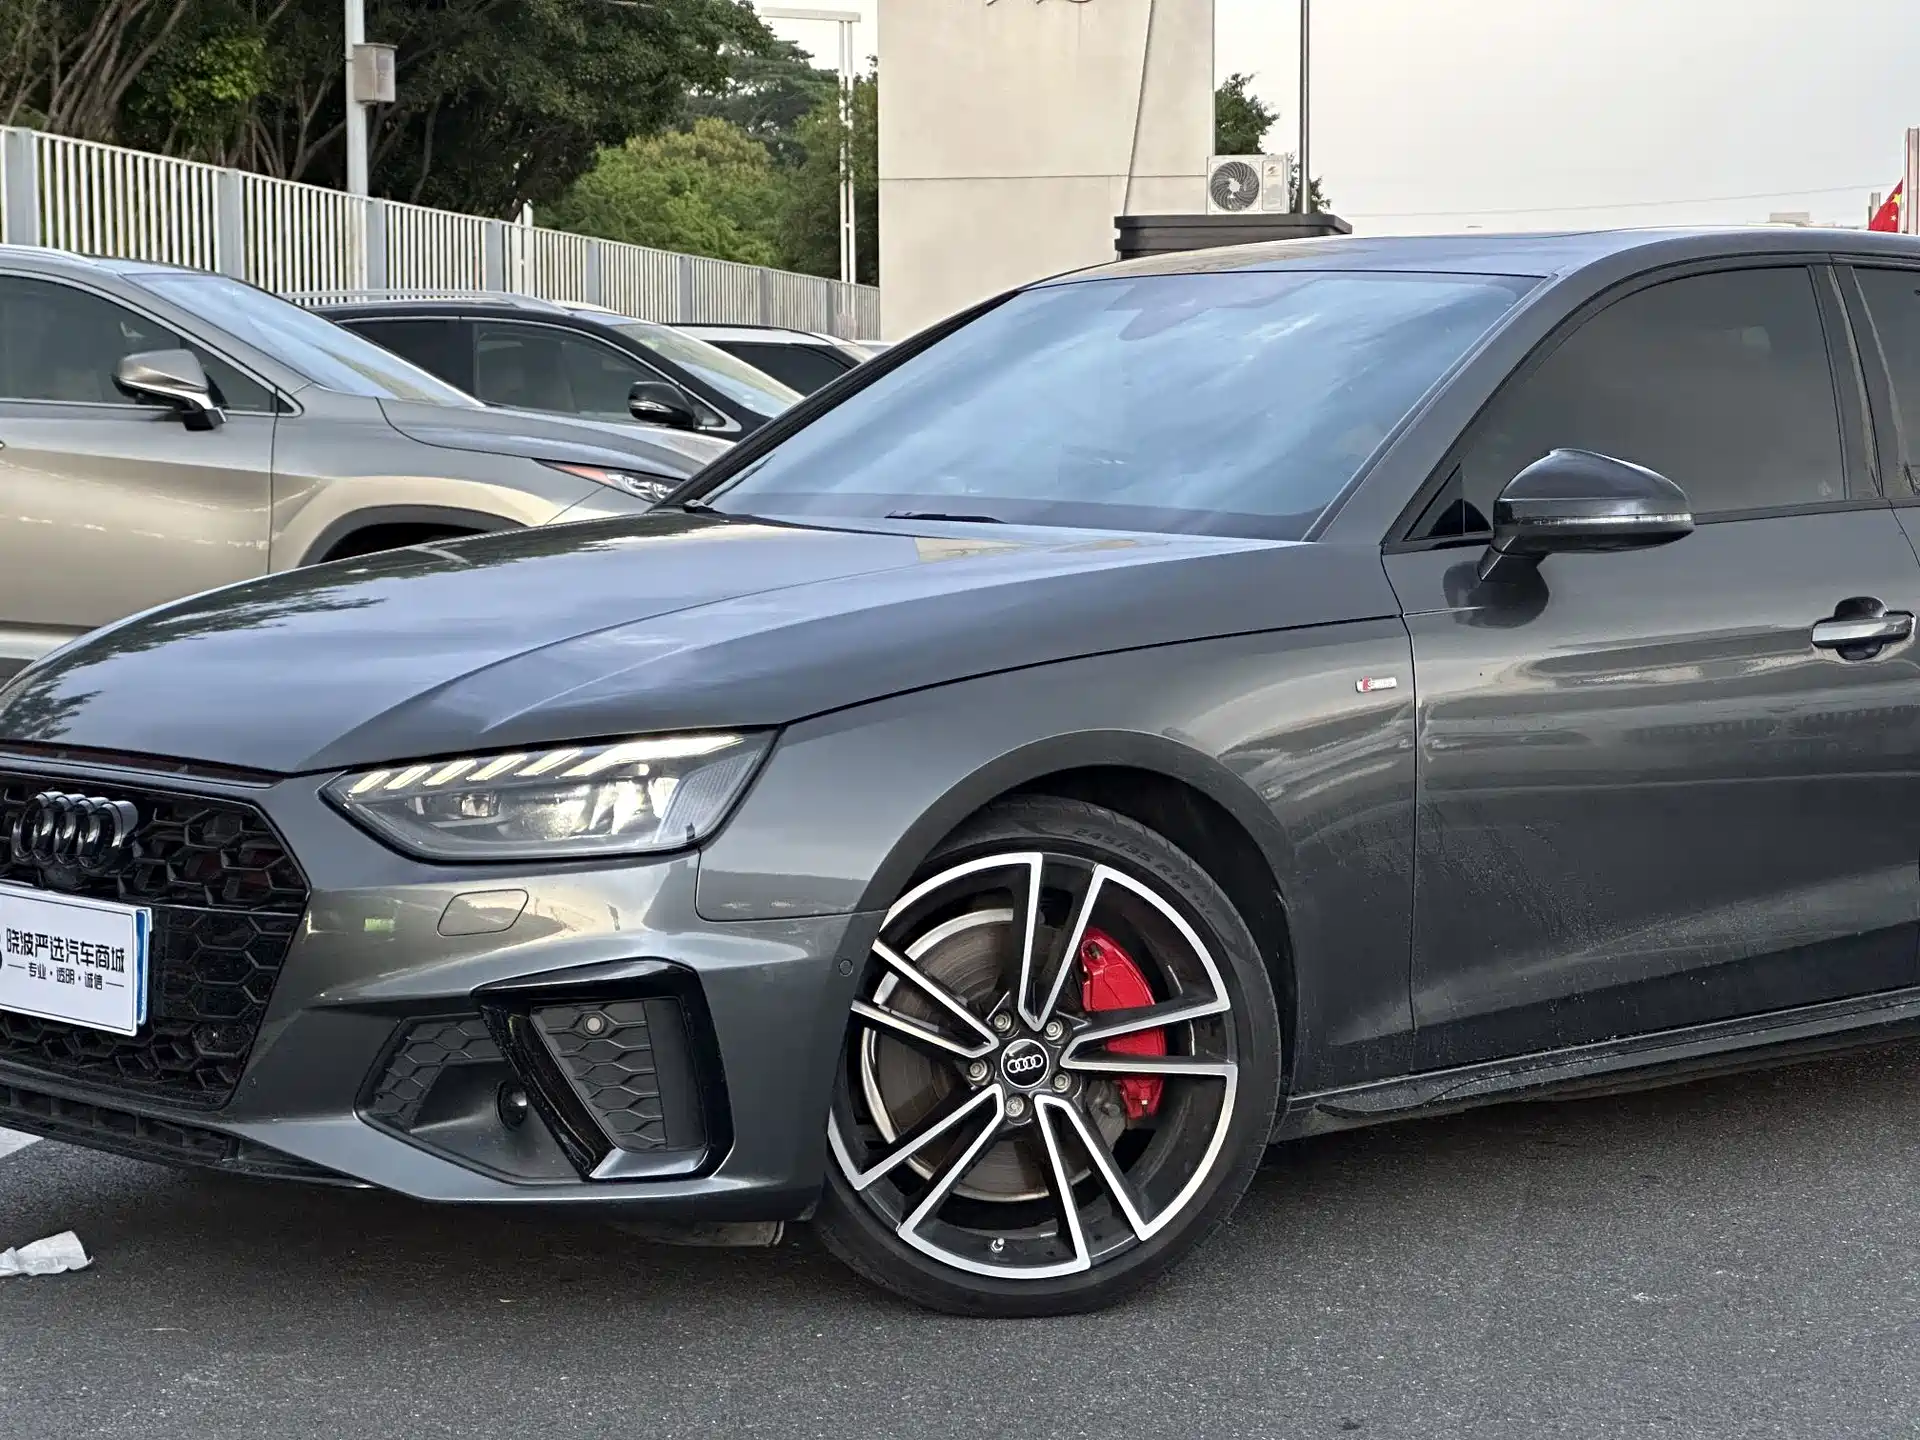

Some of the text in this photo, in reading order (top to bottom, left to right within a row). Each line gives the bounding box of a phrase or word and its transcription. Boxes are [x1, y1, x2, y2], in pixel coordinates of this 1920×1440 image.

[6, 928, 125, 973] 晓波严选汽车商城
